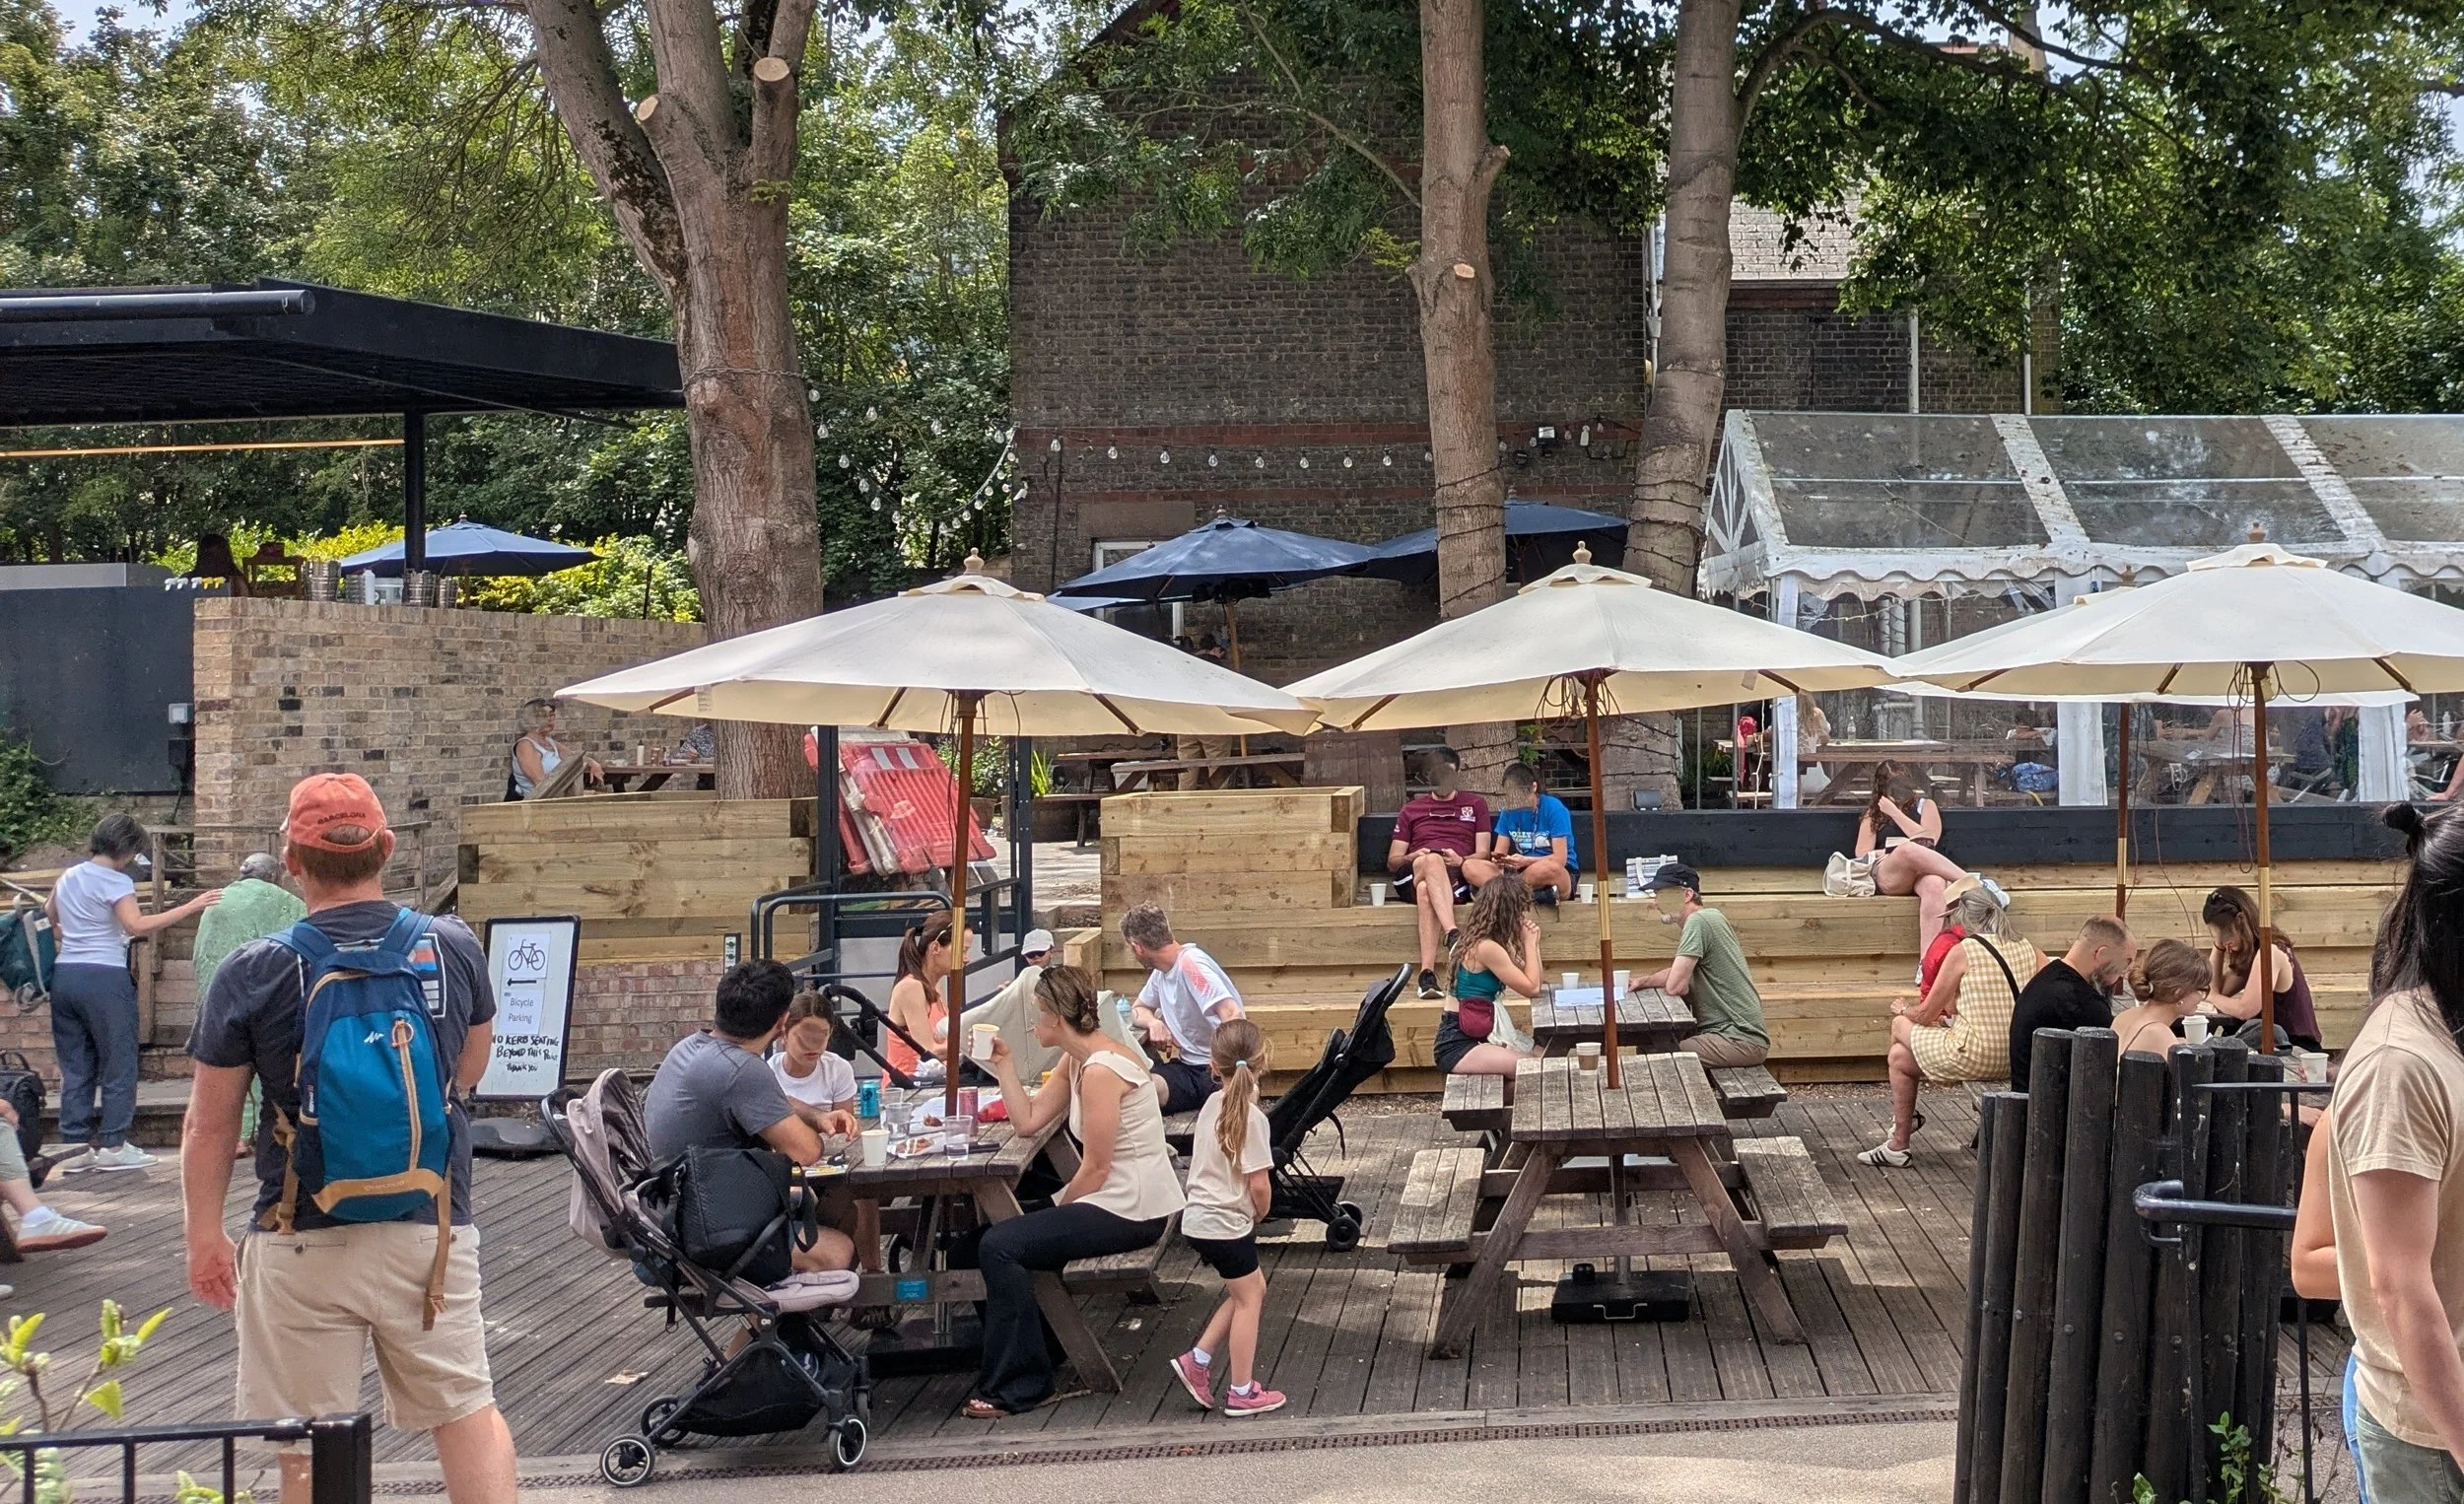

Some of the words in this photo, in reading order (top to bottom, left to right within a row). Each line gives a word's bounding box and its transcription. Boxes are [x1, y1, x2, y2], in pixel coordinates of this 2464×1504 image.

[317, 812, 366, 824] BARCELONA
[510, 997, 533, 1007] Bicycle
[508, 1013, 532, 1024] Parking
[506, 1035, 528, 1045] KERB
[496, 1046, 525, 1059] BEYOND
